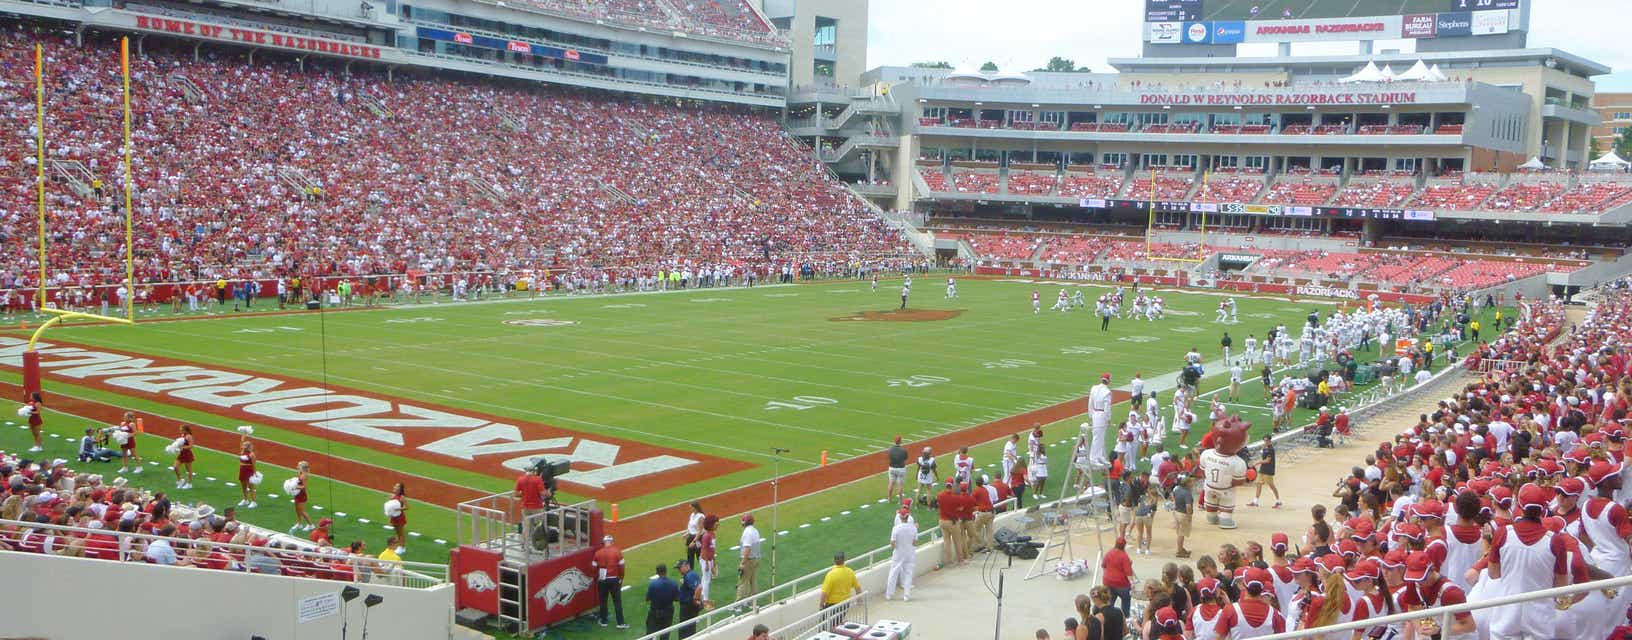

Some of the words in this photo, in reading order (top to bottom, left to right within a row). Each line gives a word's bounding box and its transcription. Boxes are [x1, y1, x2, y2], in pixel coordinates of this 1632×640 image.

[1256, 25, 1311, 35] ARKANSAS
[1315, 22, 1385, 34] RAZORBACKS
[1439, 20, 1469, 30] Stephens
[136, 15, 195, 35] HOME
[201, 24, 223, 38] OF
[229, 28, 265, 45] THE
[272, 34, 382, 59] RAZORBACKS
[1140, 94, 1190, 105] DONALD
[1193, 94, 1205, 104] W
[1207, 94, 1273, 105] REYNOLDS
[1275, 93, 1355, 104] RAZORBACK
[1357, 92, 1417, 103] STADIUM
[764, 395, 839, 411] 10
[0, 336, 700, 489] RAZORBACK
